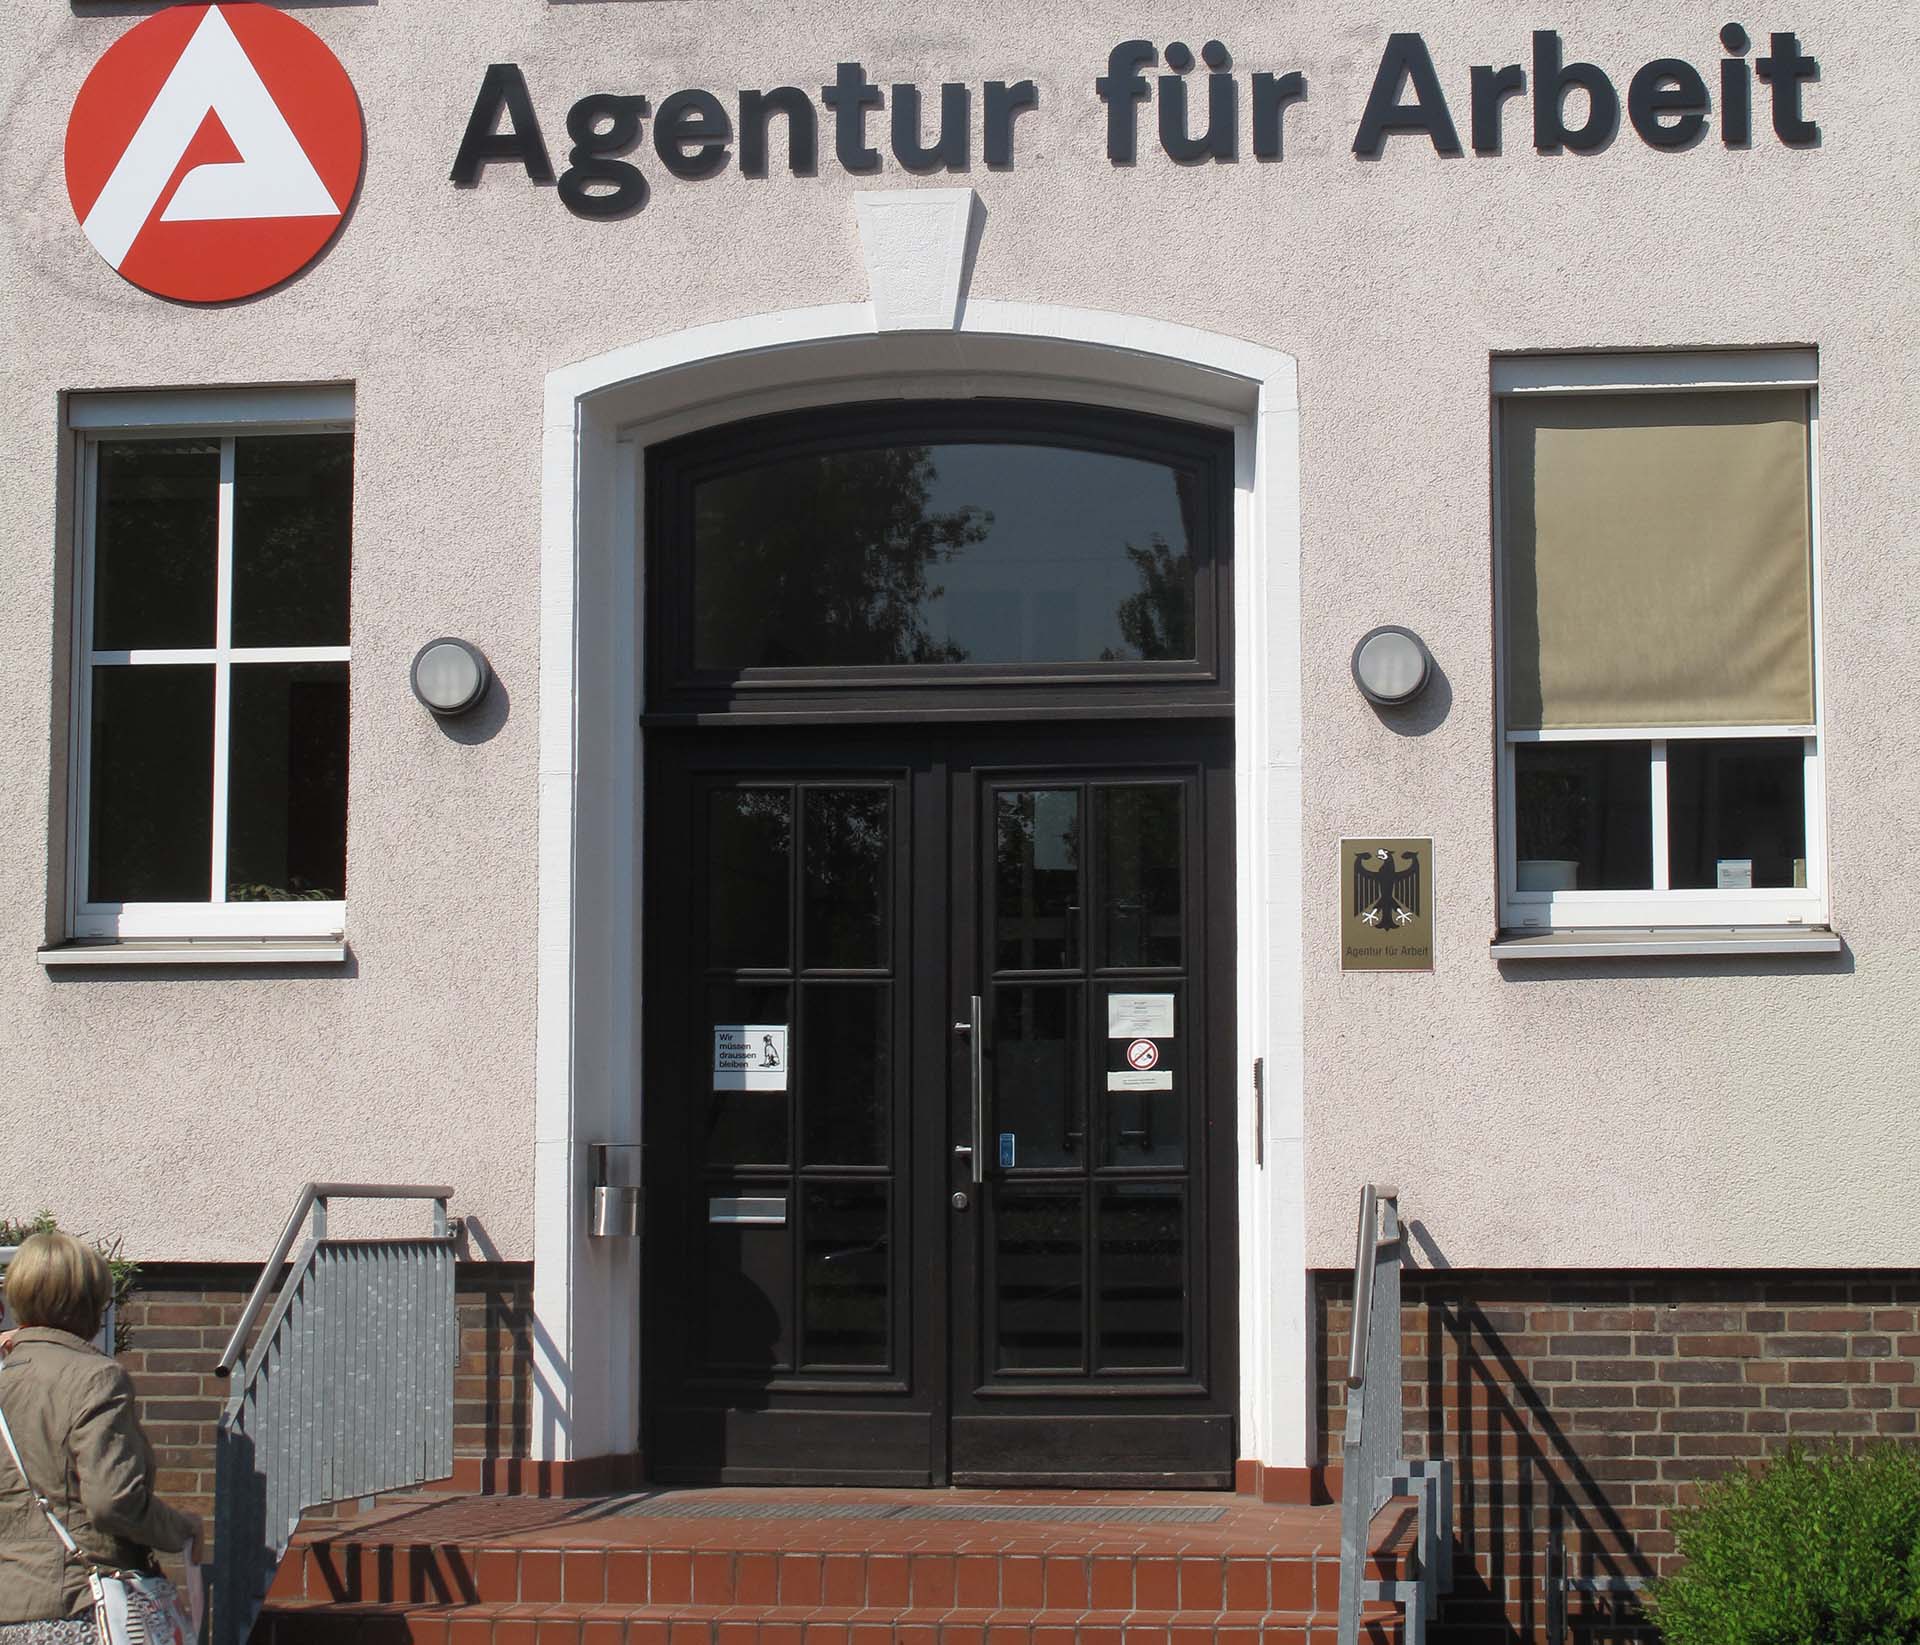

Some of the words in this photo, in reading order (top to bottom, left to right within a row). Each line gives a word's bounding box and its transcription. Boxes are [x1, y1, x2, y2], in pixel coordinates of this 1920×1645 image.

[449, 62, 1038, 220] Agentur
[1097, 40, 1304, 164] für
[1353, 22, 1818, 157] Arbeit
[1346, 946, 1382, 958] Agentur
[1385, 946, 1398, 956] für
[1401, 946, 1428, 956] Arbeit
[719, 1033, 734, 1041] Wir
[719, 1042, 752, 1050] müssen
[719, 1051, 757, 1059] draussen
